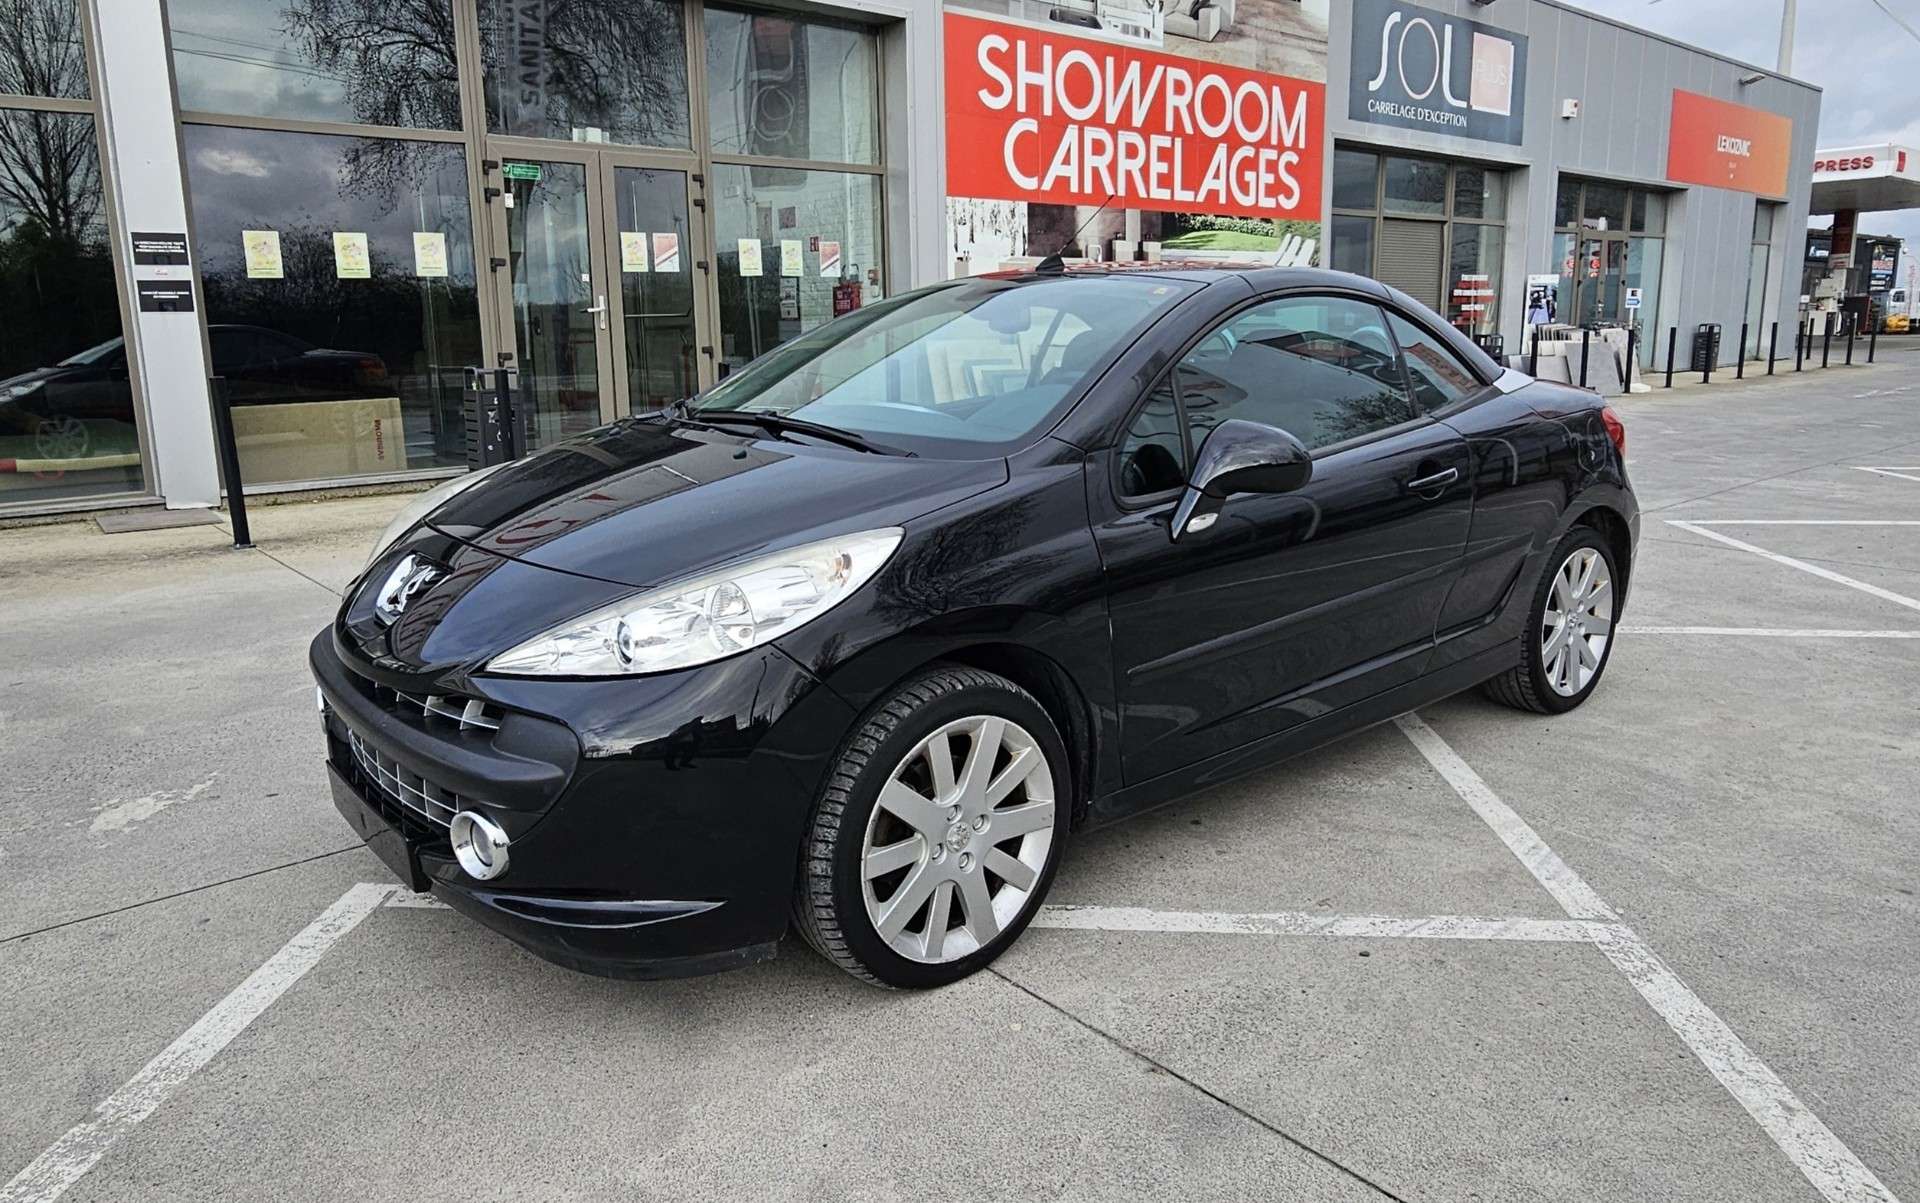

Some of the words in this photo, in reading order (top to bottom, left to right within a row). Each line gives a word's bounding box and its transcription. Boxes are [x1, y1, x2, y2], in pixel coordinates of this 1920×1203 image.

[977, 34, 1307, 150] SHOWROOM
[1368, 11, 1468, 109] SOL
[1368, 99, 1417, 120] CARRELAGE
[1418, 106, 1468, 129] D'EXCEPTION
[1003, 118, 1301, 210] CARRELAGES
